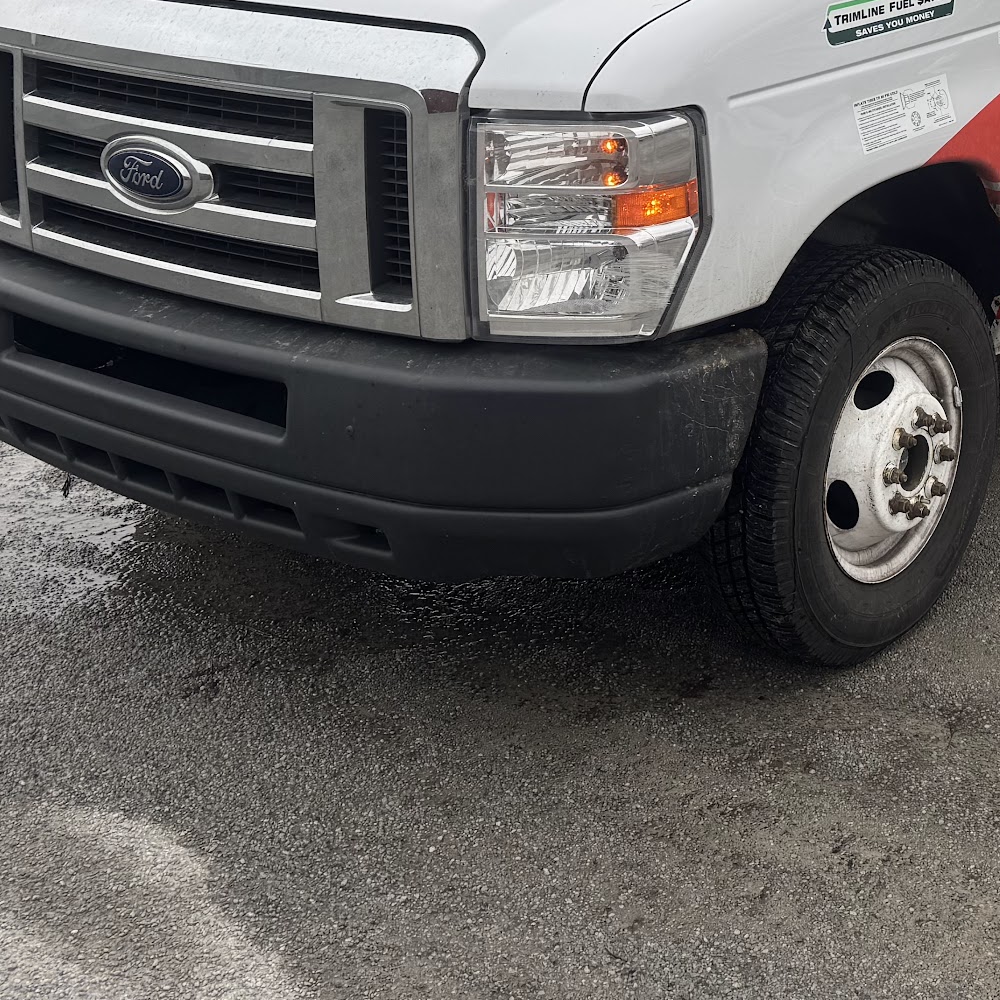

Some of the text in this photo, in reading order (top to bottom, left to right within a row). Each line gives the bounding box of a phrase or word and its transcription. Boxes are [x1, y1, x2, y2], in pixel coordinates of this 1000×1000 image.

[834, 4, 886, 26] TRIMLINE
[855, 9, 936, 38] SAVES YOU MONEY
[119, 155, 165, 191] Ford
